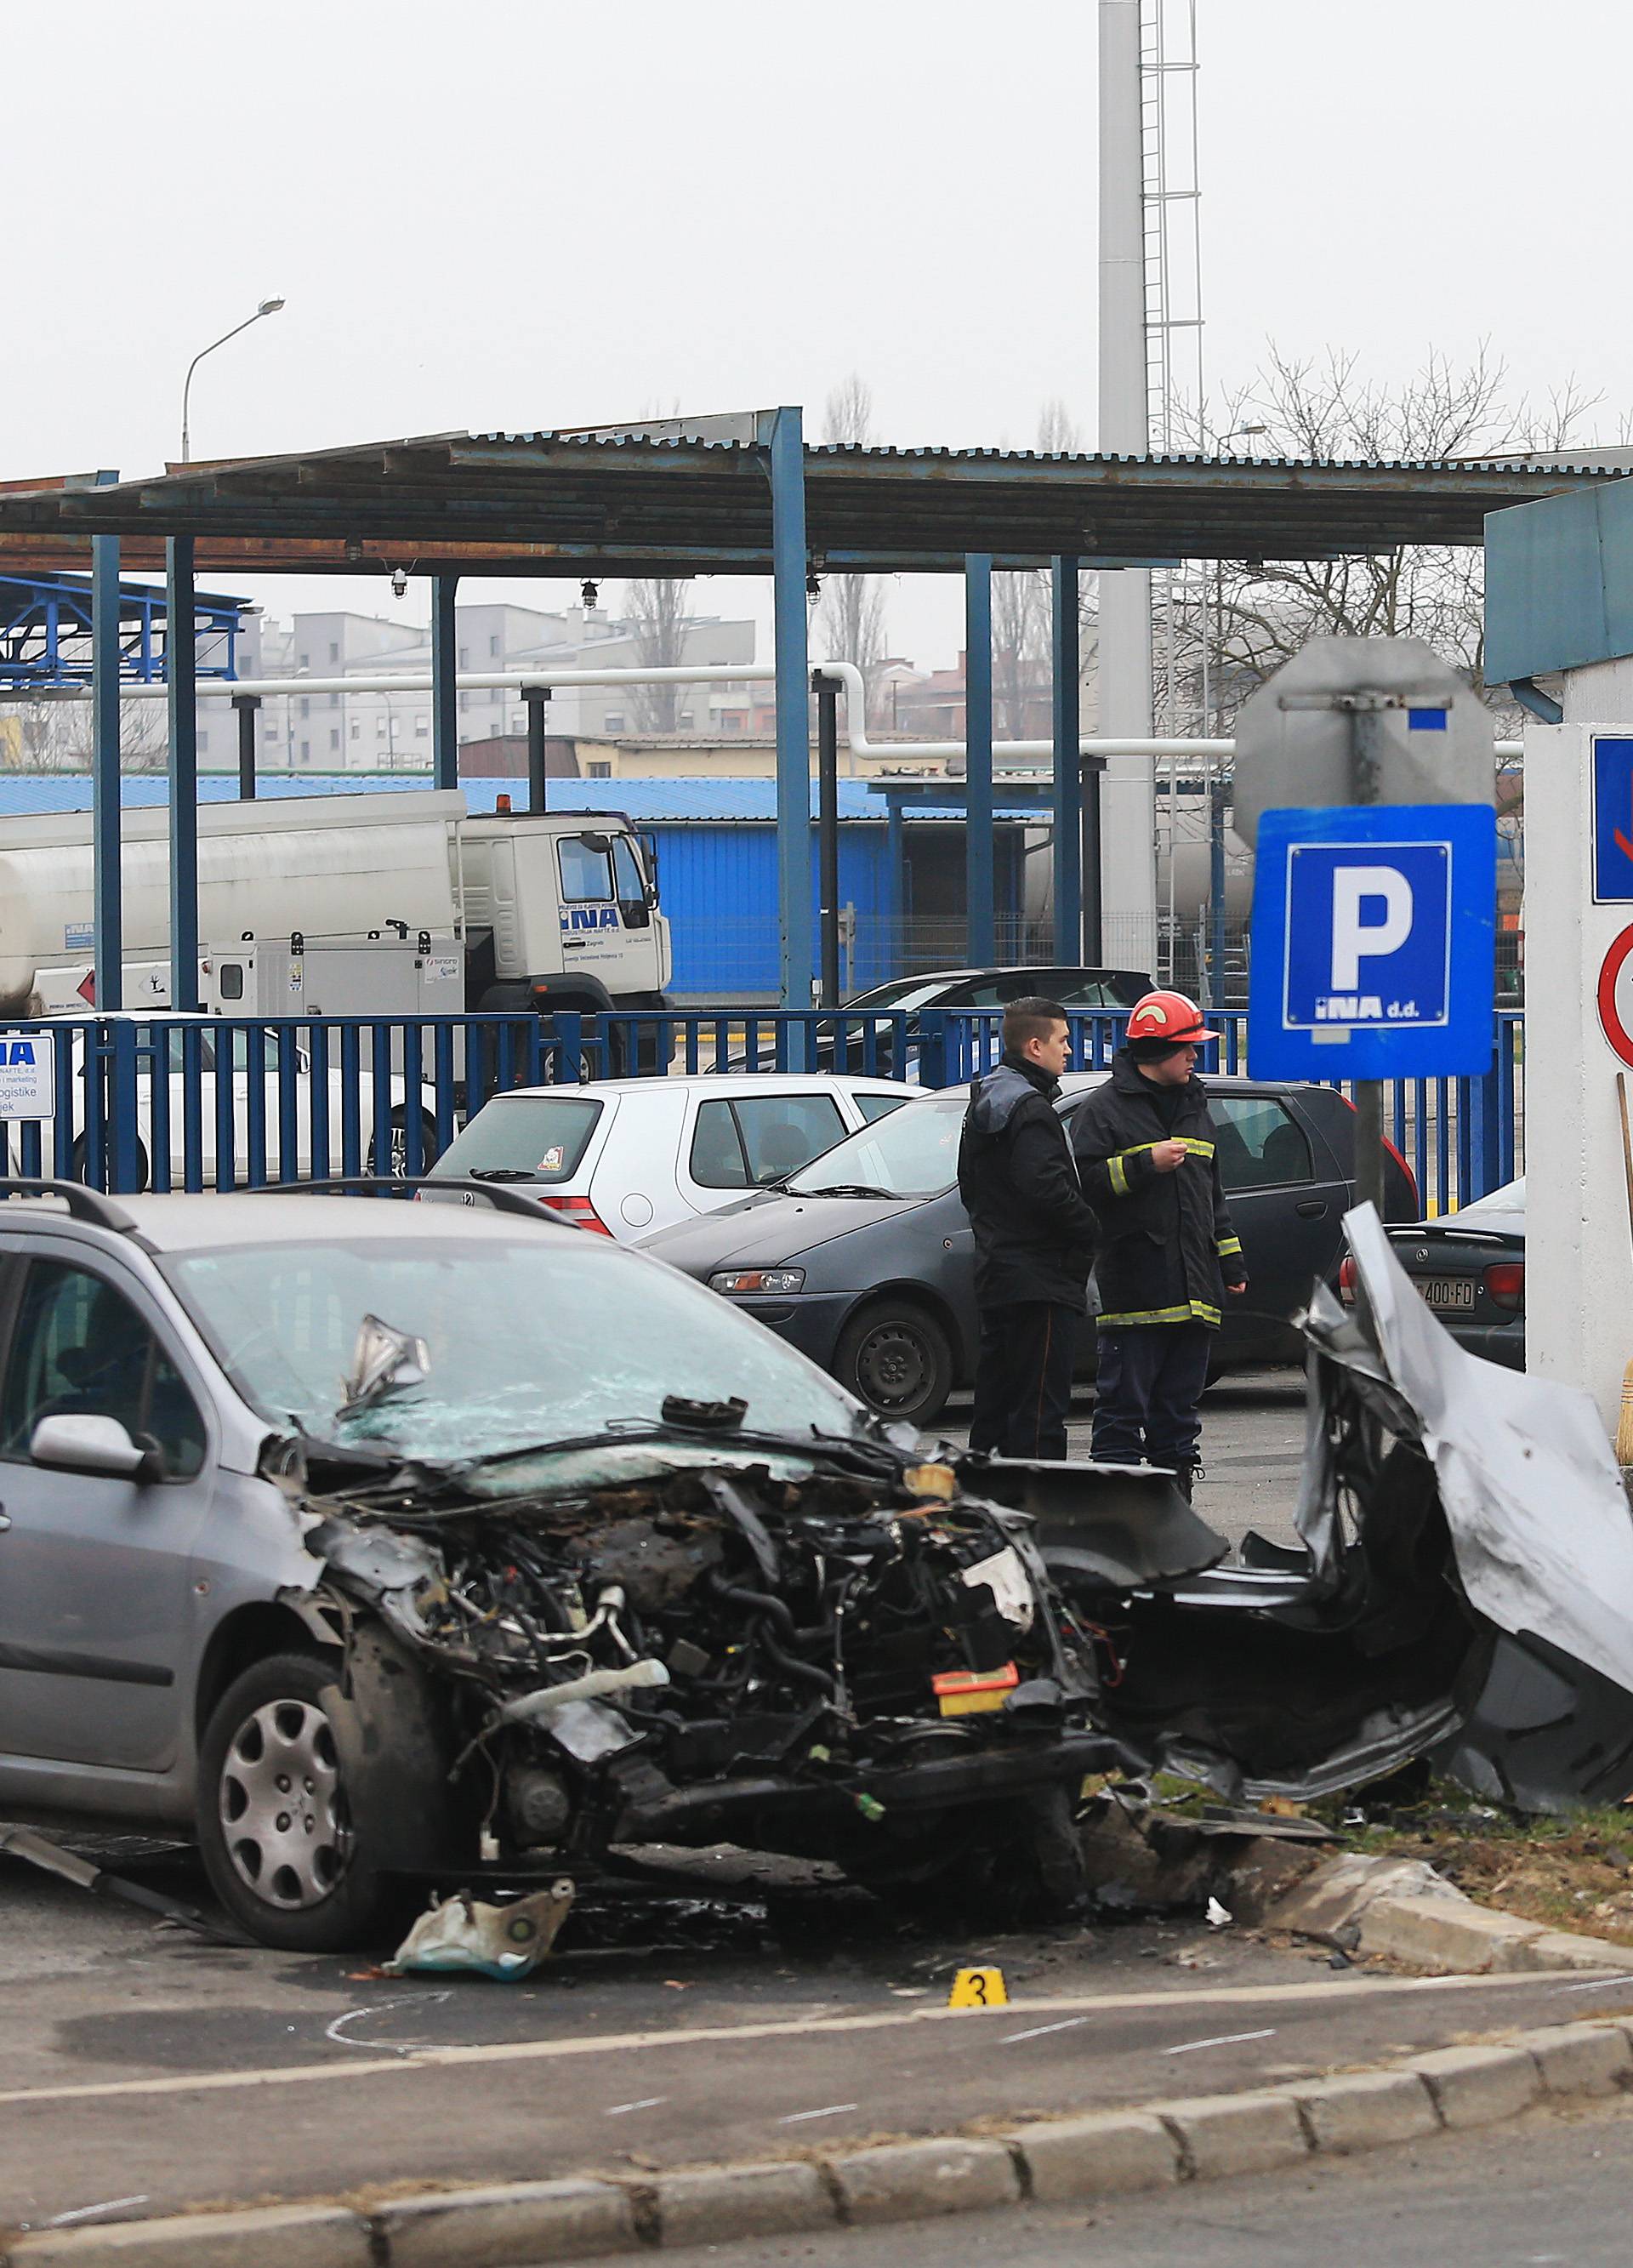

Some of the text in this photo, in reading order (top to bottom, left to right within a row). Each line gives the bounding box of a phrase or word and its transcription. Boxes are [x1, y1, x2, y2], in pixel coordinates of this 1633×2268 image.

[1332, 866, 1413, 991] P
[1387, 1000, 1420, 1018] d.d.
[968, 1975, 987, 2006] 3
